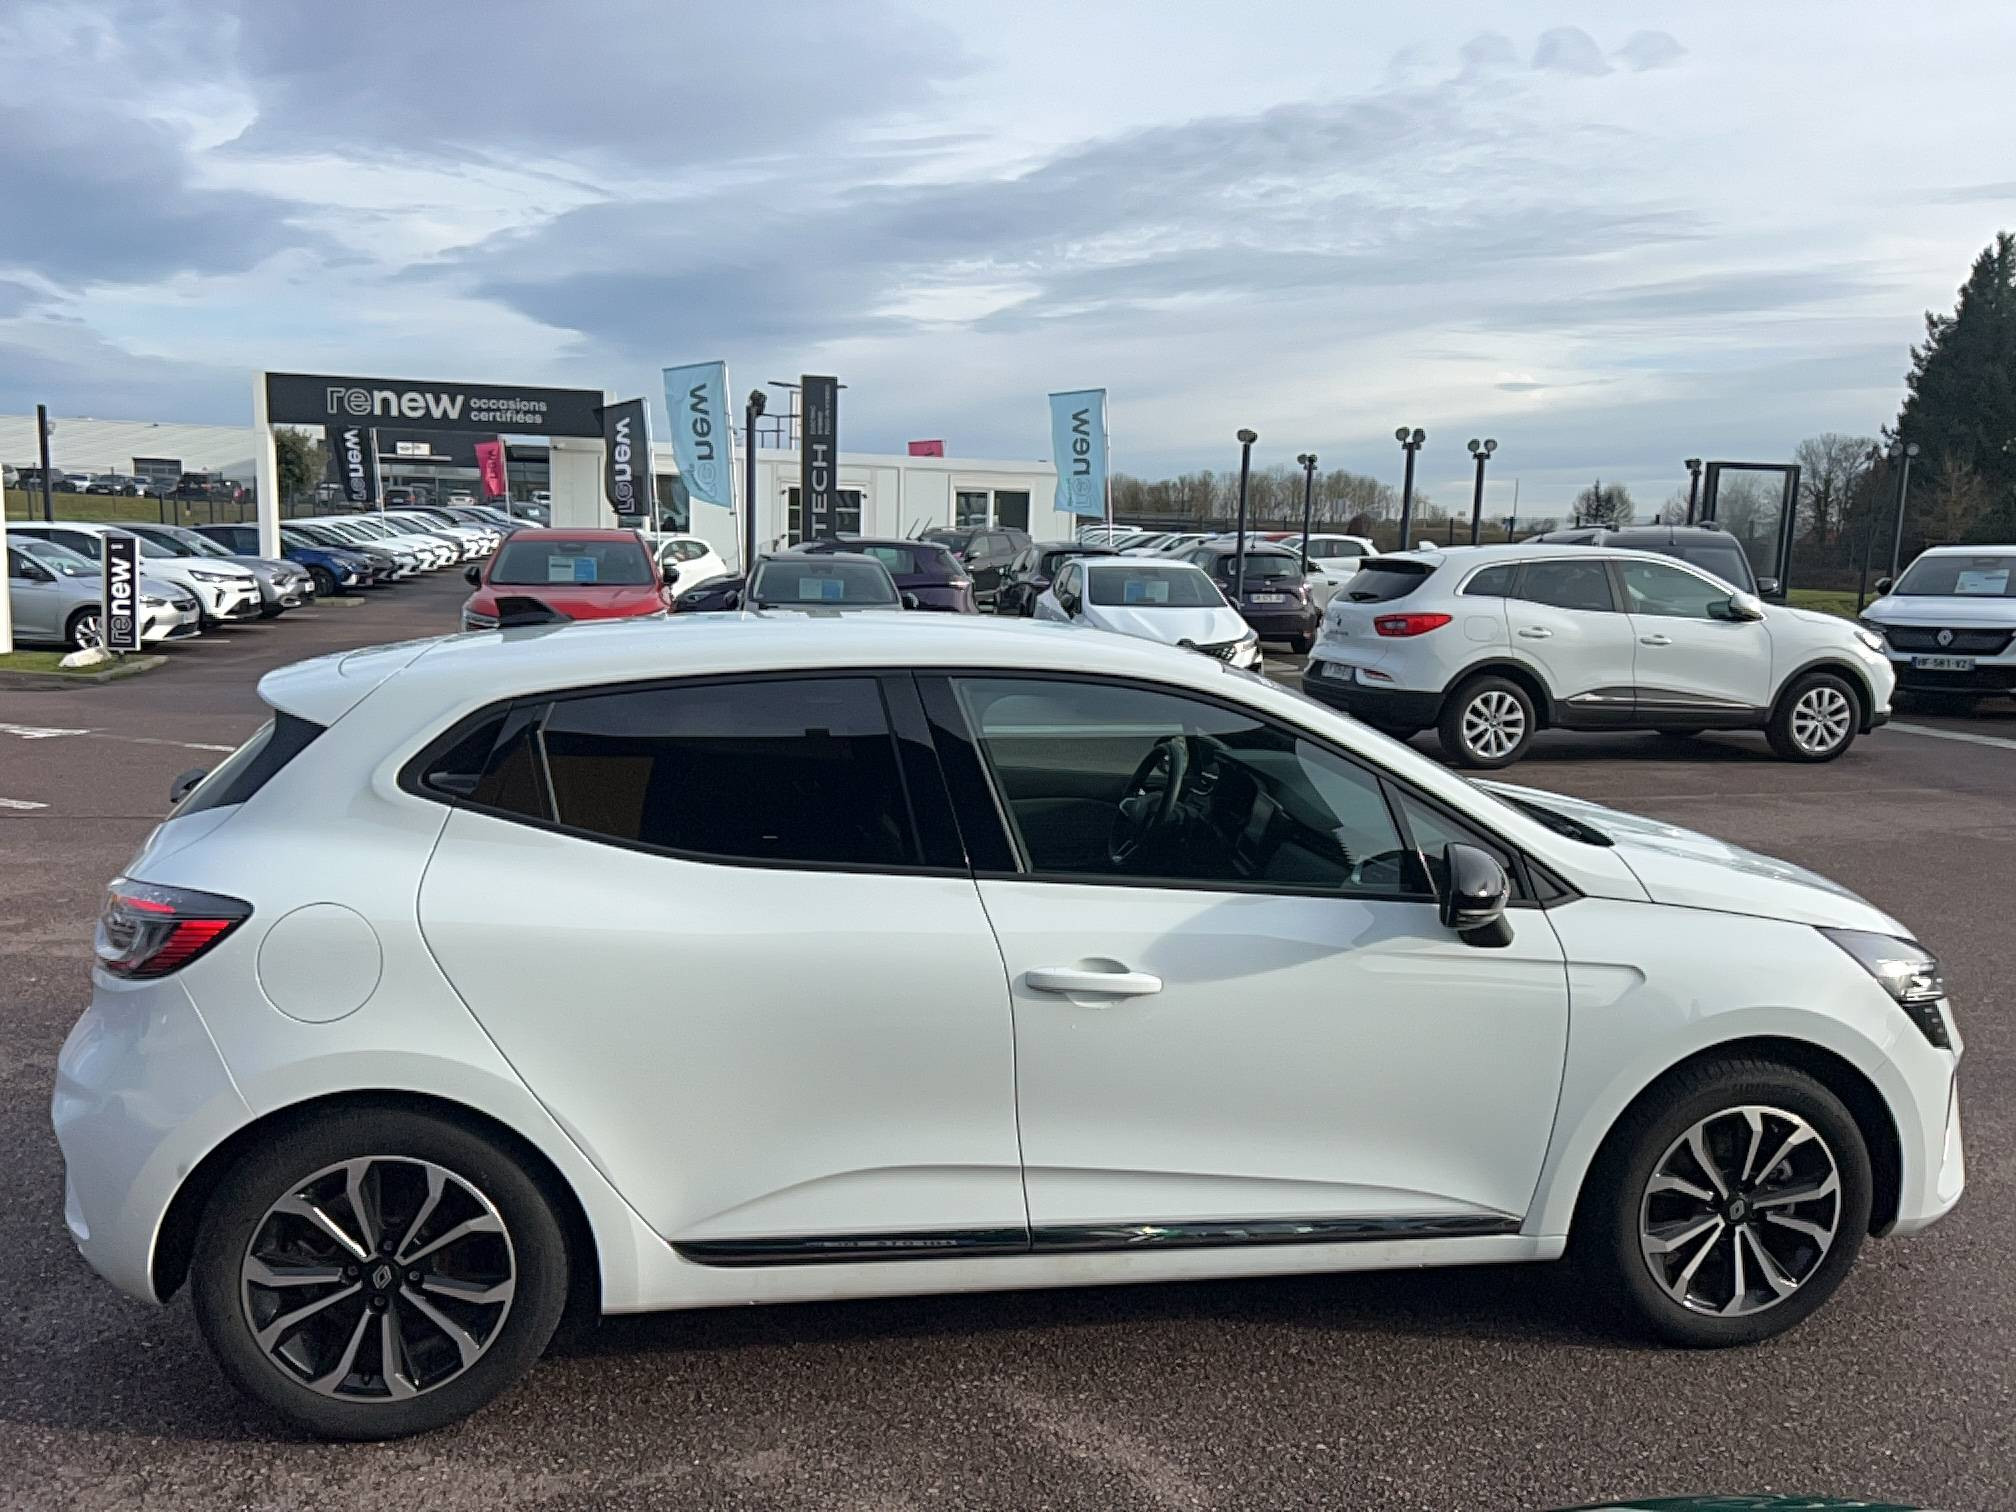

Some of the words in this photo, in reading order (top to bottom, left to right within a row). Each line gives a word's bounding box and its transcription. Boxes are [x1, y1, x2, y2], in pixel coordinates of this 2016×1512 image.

[326, 386, 465, 420] renew
[470, 397, 548, 412] occasions
[470, 409, 543, 424] certifiées
[111, 556, 133, 644] renew
